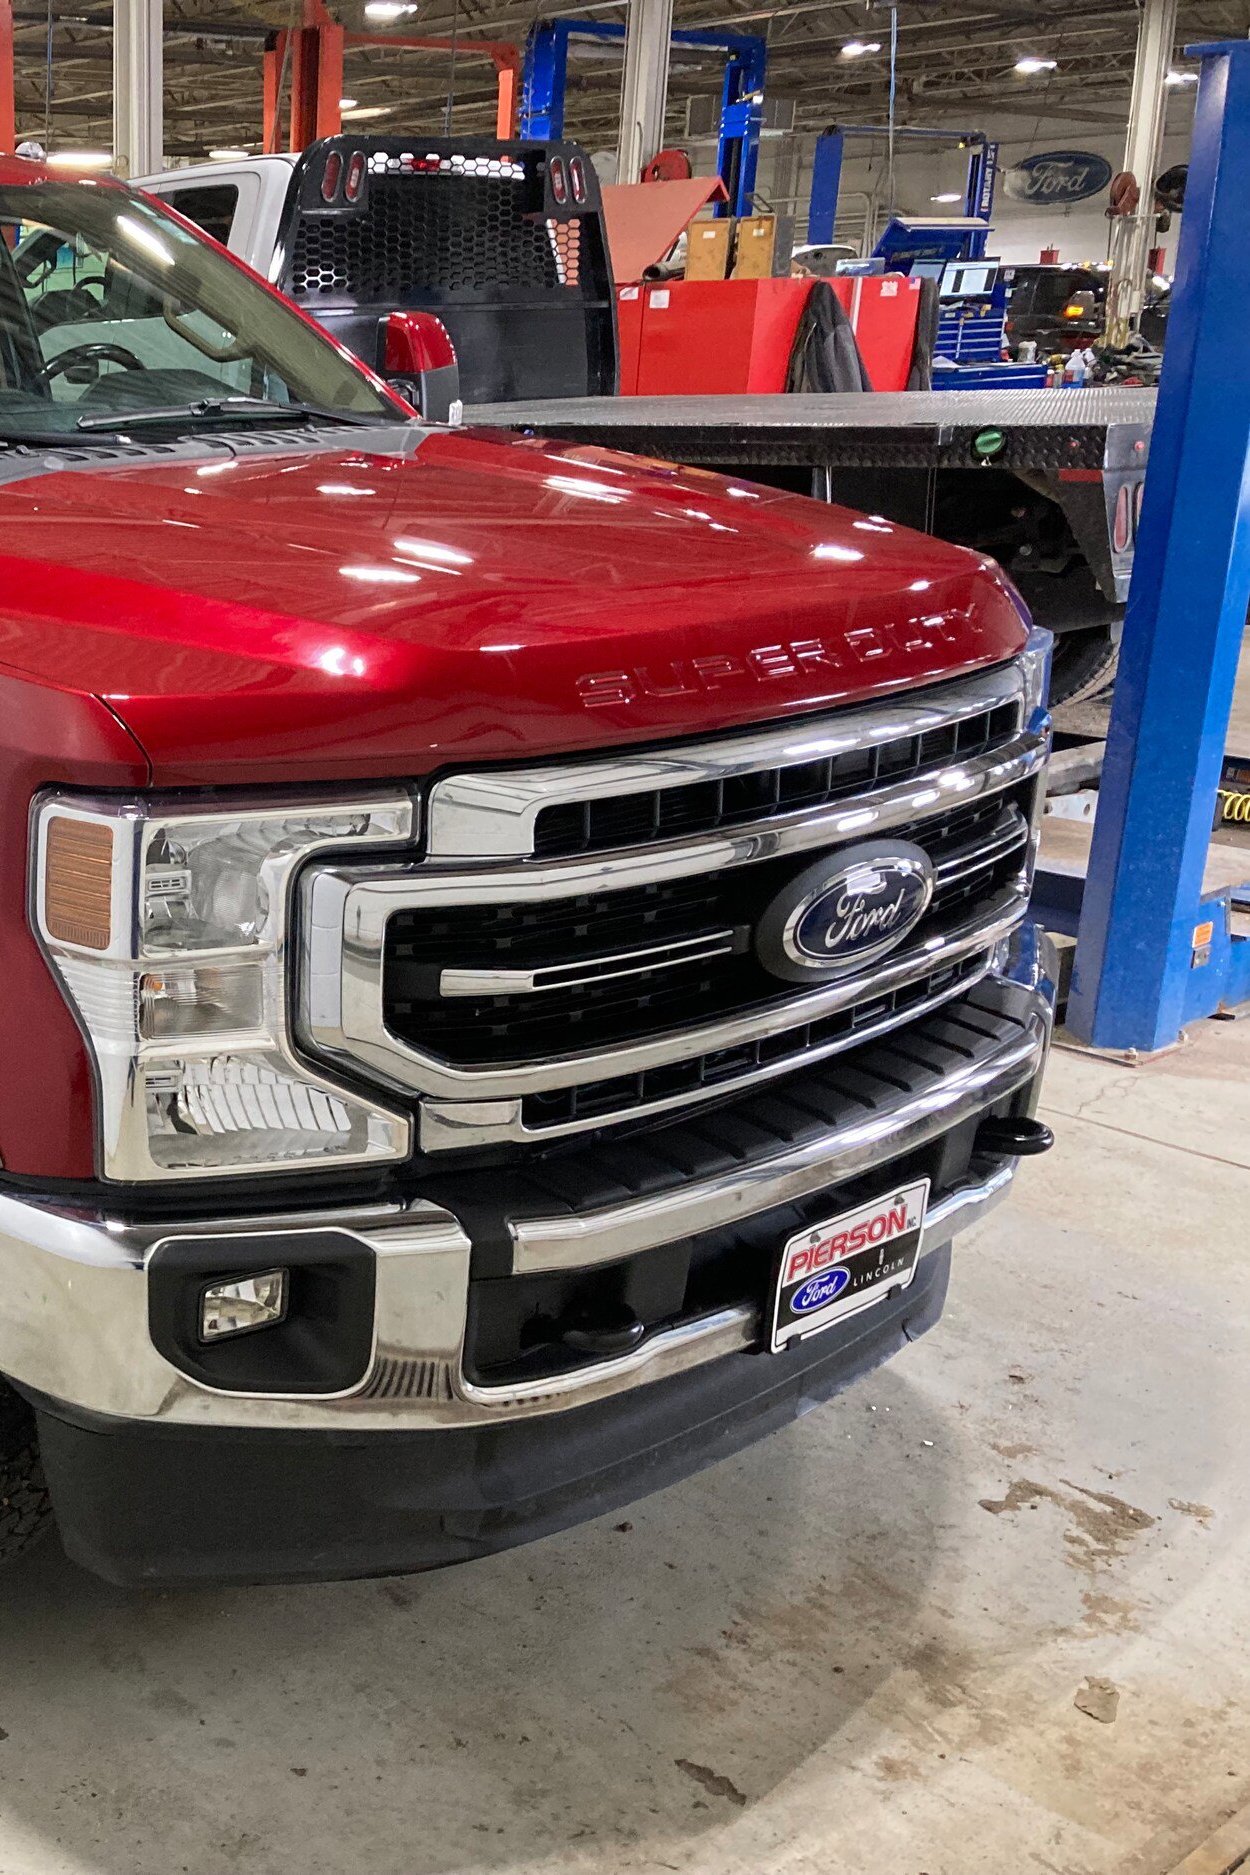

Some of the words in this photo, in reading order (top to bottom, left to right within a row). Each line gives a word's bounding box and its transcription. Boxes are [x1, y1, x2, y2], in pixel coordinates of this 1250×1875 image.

[981, 167, 993, 207] ROTARY
[1025, 160, 1090, 195] Ford
[575, 637, 844, 708] SUPER
[843, 602, 983, 663] DUTY
[825, 881, 906, 949] Ford
[787, 1203, 908, 1283] PIERSON
[801, 1274, 839, 1307] Ford
[853, 1256, 905, 1287] LINCOLN
